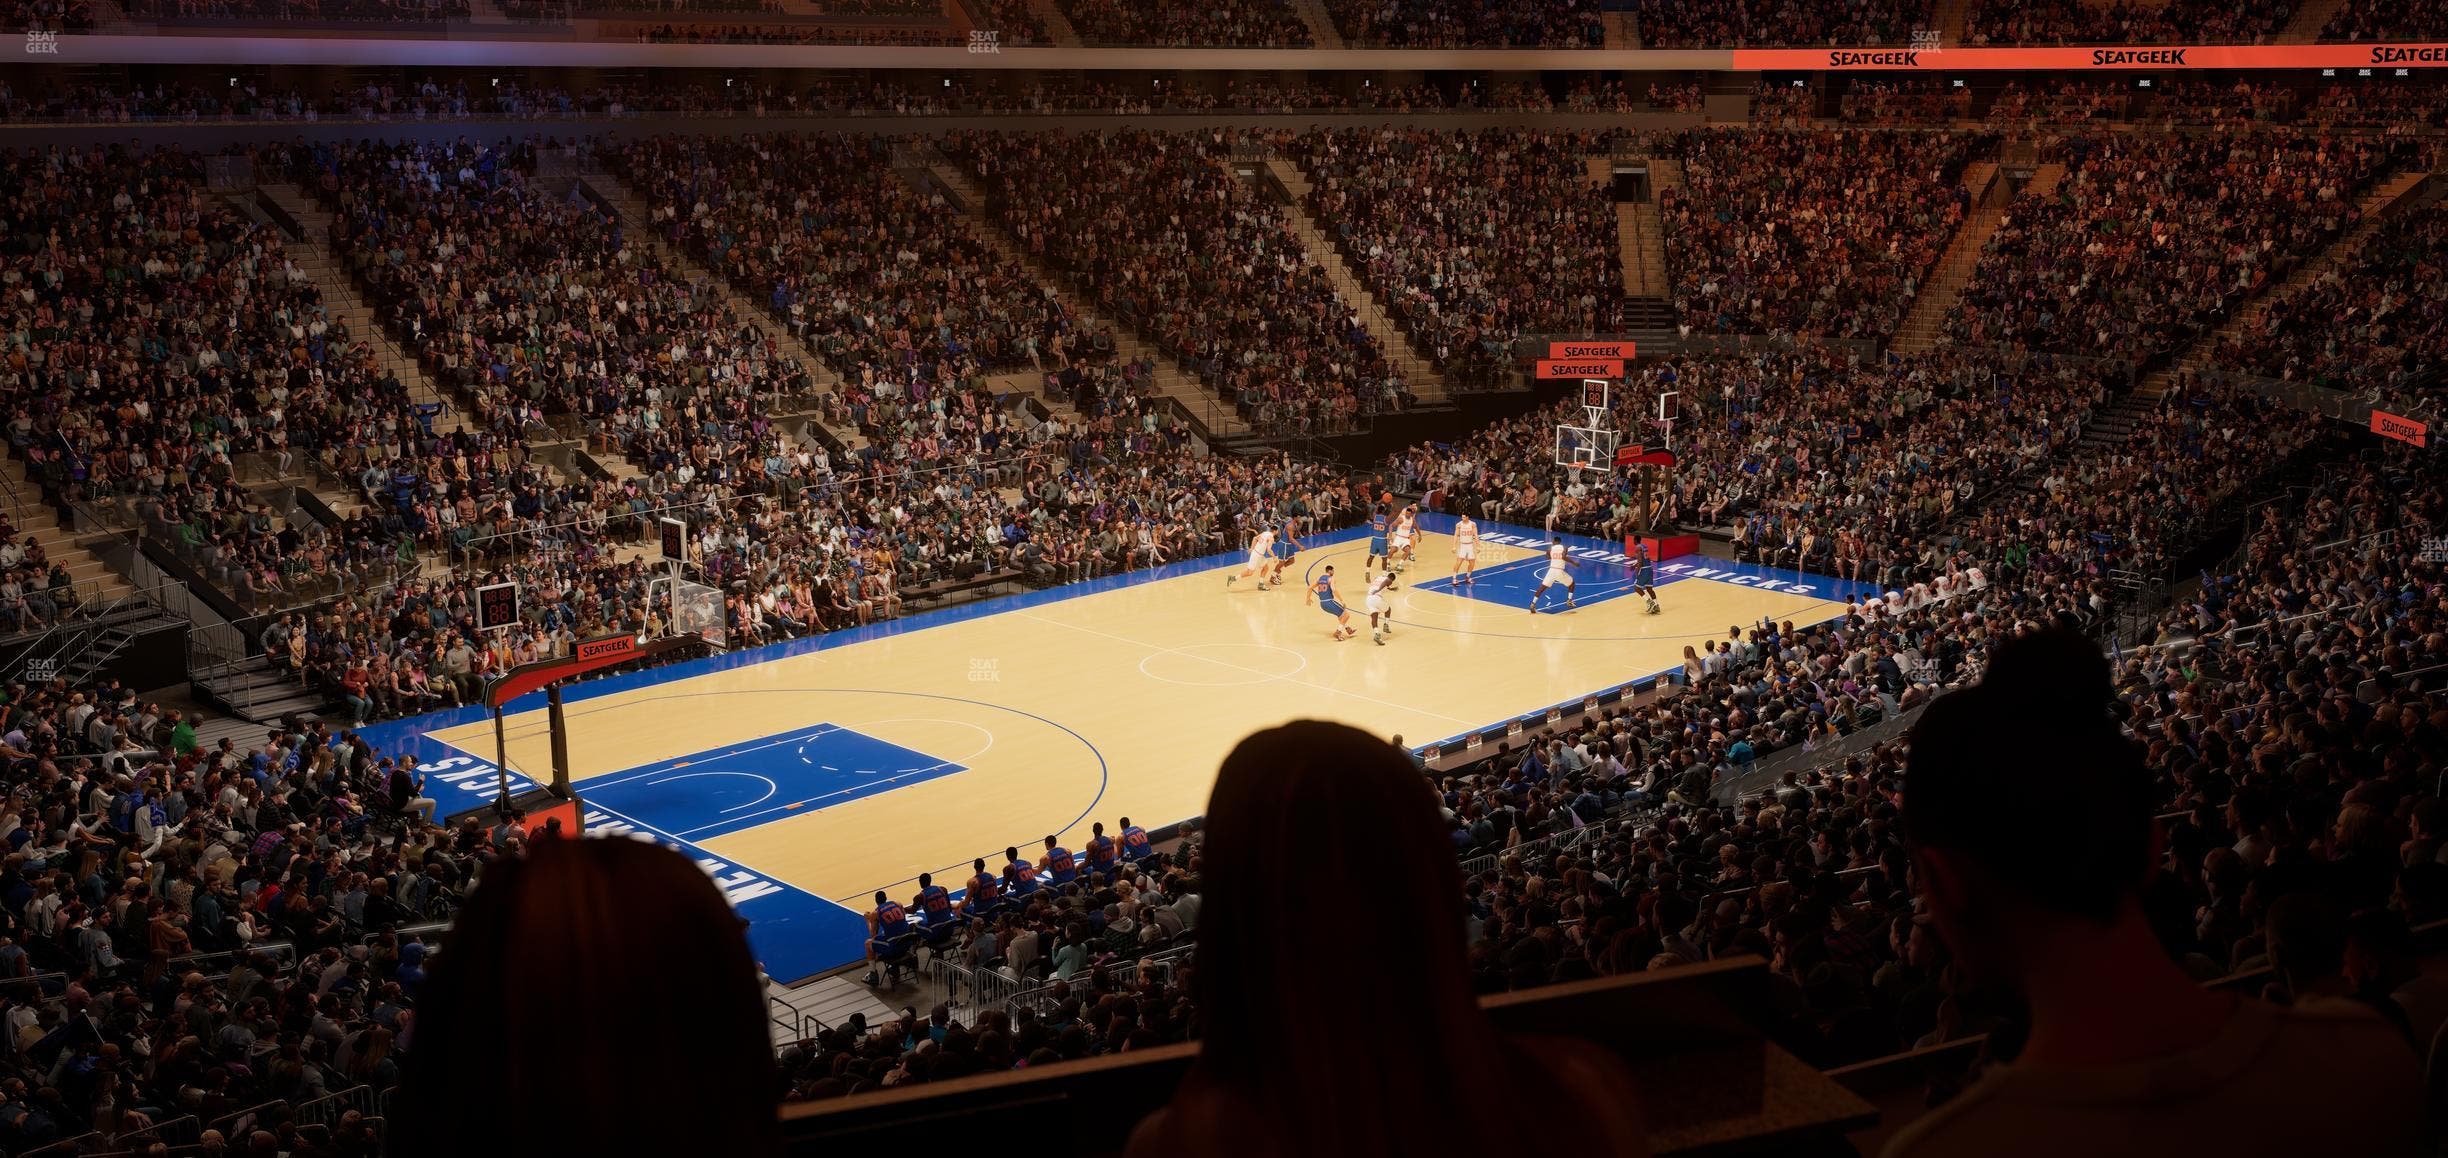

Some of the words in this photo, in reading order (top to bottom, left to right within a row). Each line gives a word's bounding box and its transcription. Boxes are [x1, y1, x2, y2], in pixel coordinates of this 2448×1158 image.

[1830, 52, 1918, 66] SEATGEEK
[2093, 49, 2186, 65] SEATGEEK
[1565, 346, 1621, 357] SEATGEEK
[1552, 365, 1608, 375] SEATGEEK
[2381, 418, 2417, 441] SEATGEEK
[1658, 563, 1817, 594] KNICKS
[583, 639, 629, 657] SEATGEEK
